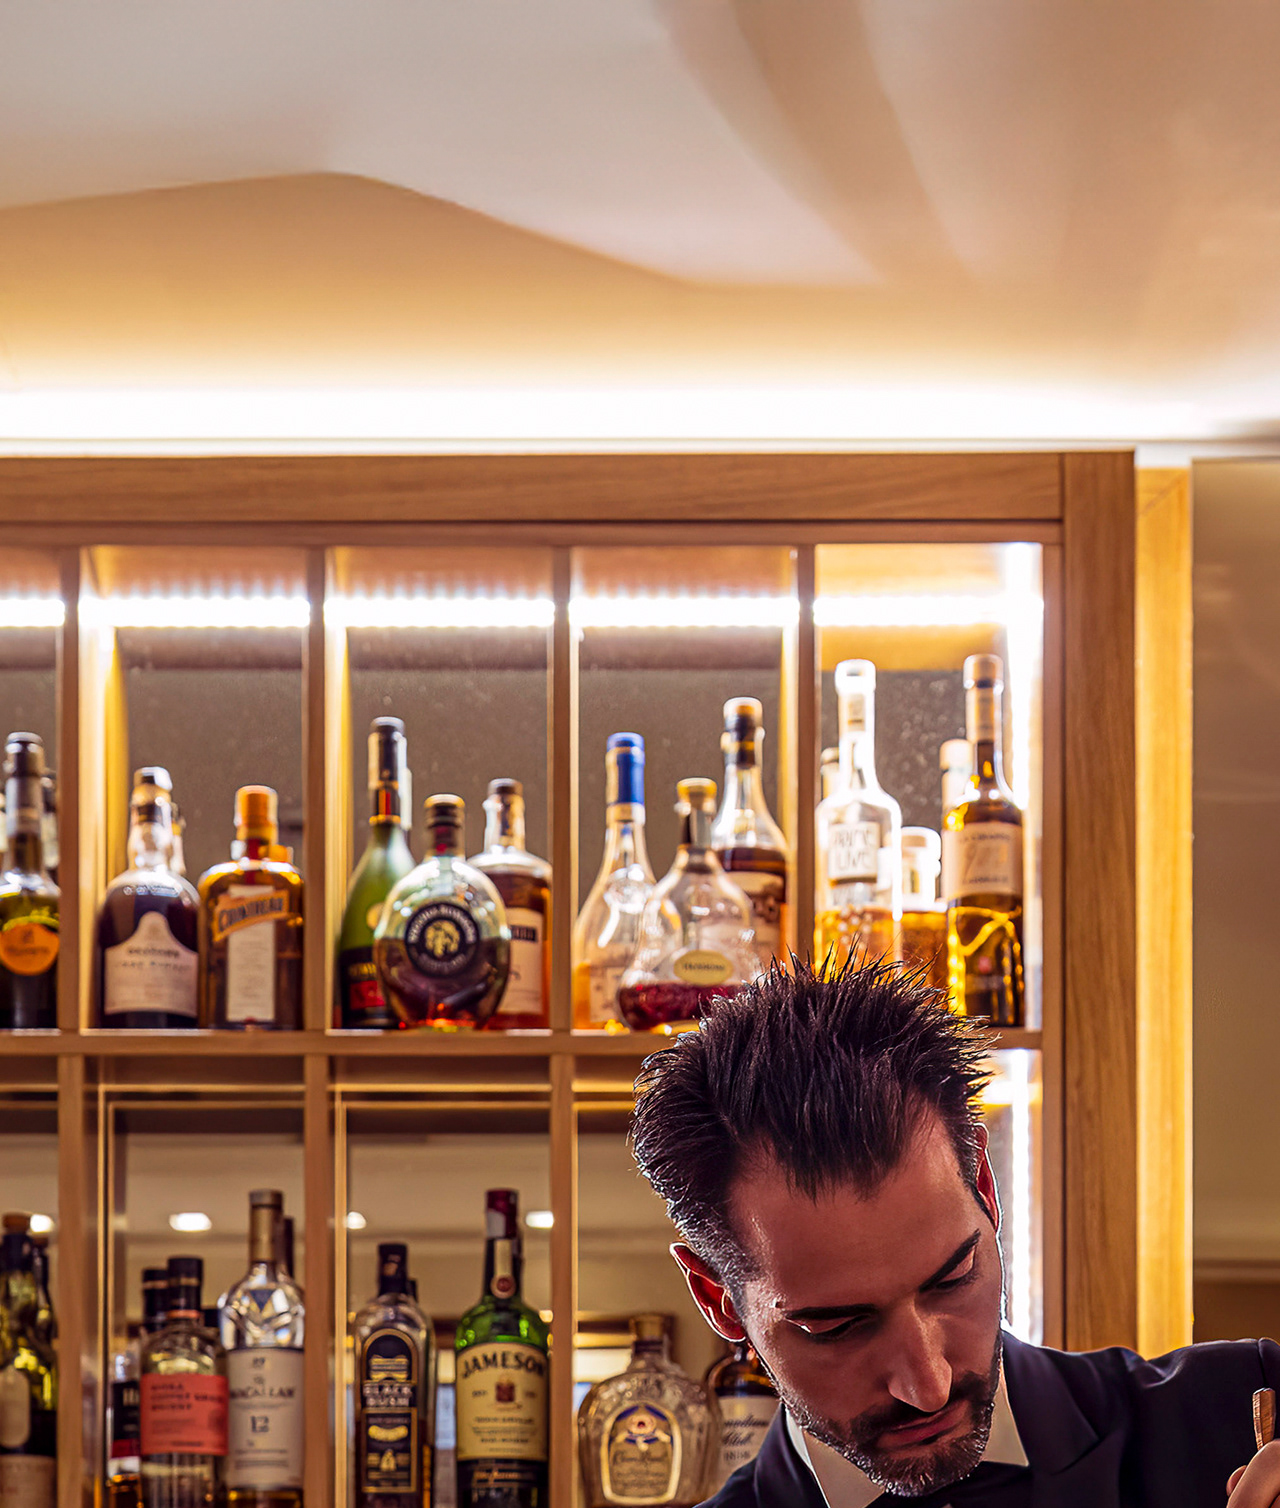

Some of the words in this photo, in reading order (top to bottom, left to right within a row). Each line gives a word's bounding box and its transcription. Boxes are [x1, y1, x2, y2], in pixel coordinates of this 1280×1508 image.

[220, 898, 284, 933] COINTREAU
[462, 1350, 545, 1379] JAMESON
[250, 1415, 269, 1433] 12
